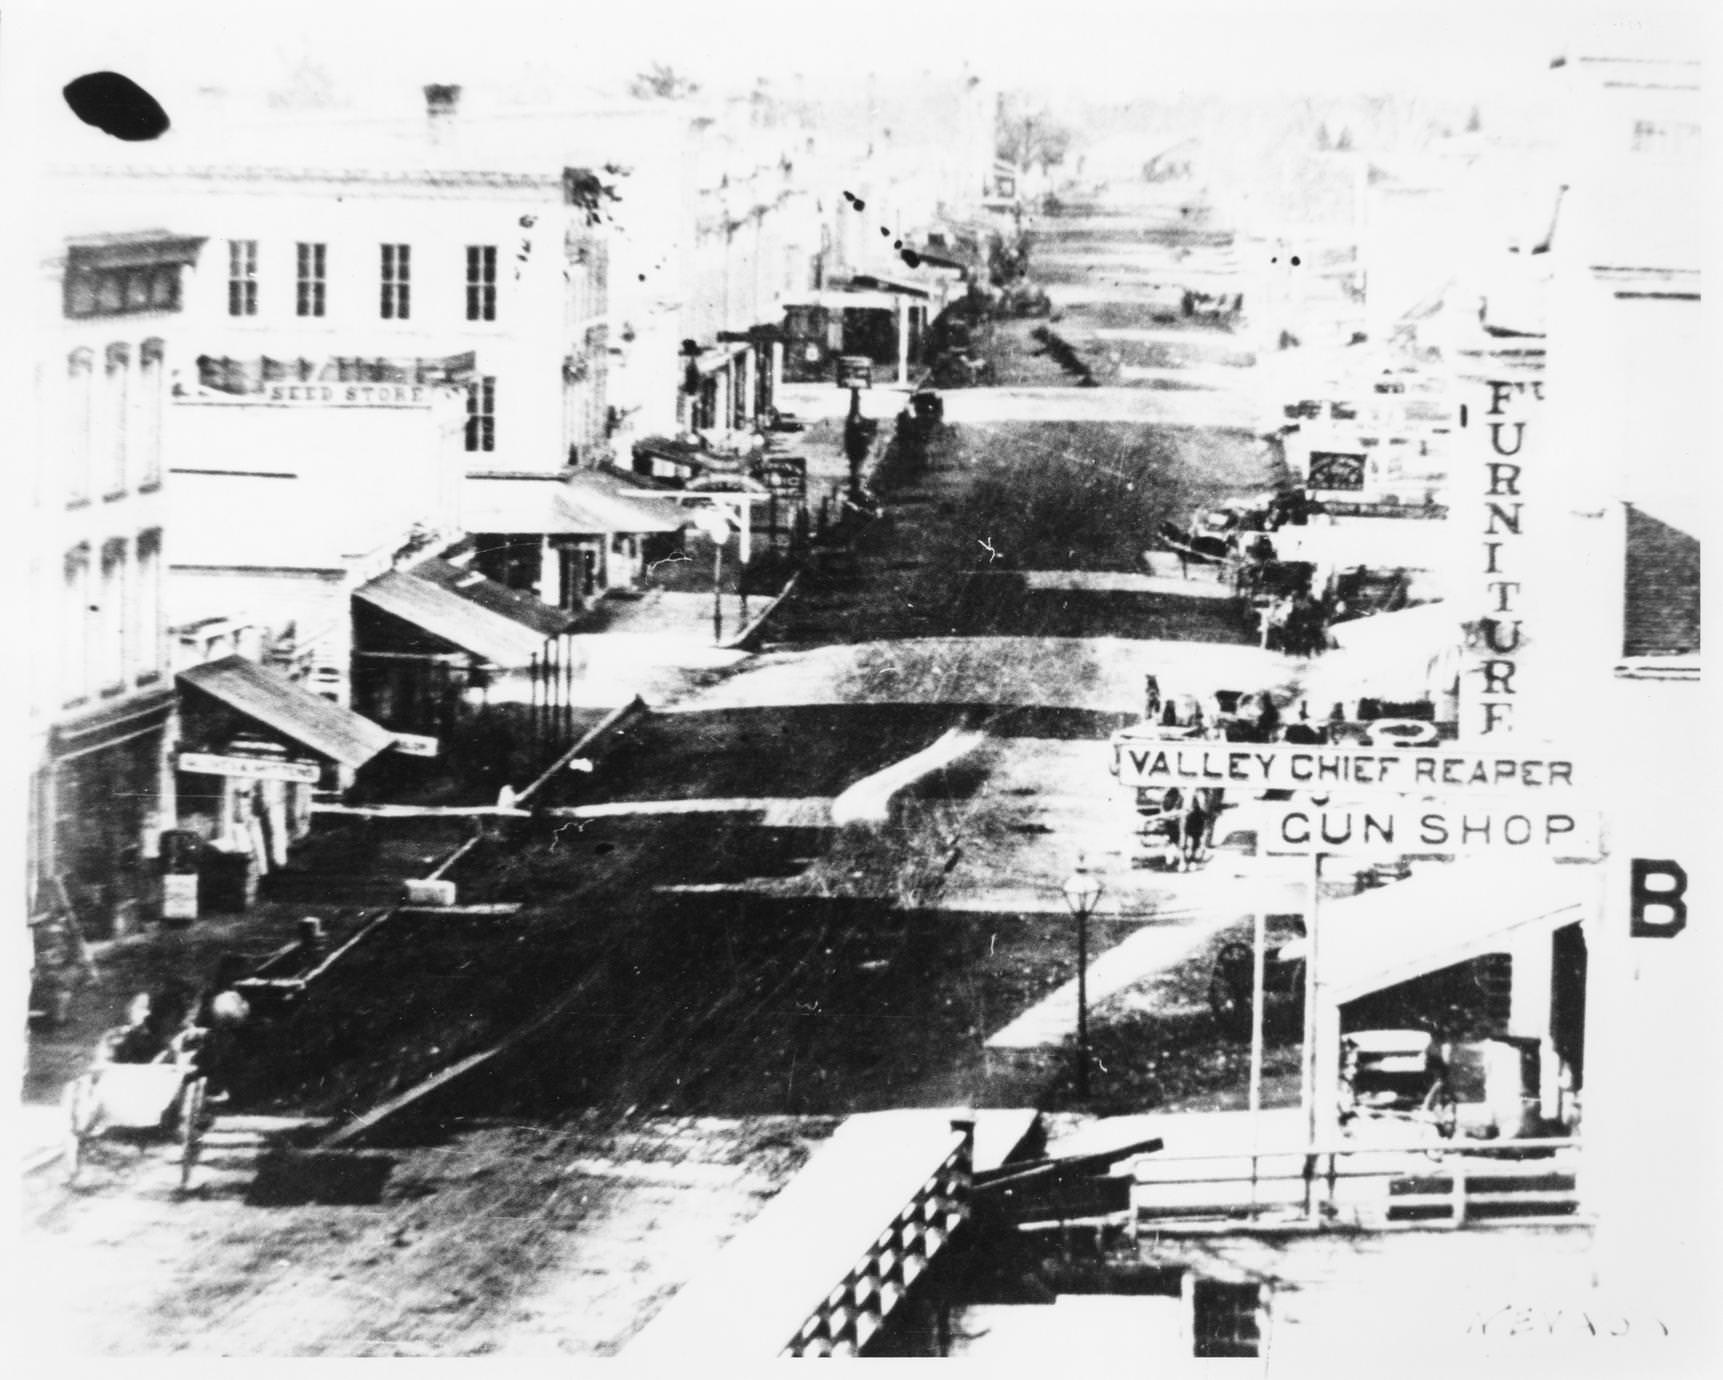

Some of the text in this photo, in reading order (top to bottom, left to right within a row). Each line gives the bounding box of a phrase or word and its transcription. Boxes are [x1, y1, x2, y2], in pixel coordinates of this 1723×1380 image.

[271, 385, 424, 404] SEED STORE
[1480, 380, 1527, 735] FURNITURE
[1128, 749, 1574, 787] VALLEY CHIEF REAPER
[1282, 812, 1576, 846] GUN SHOP
[1630, 858, 1688, 938] B
